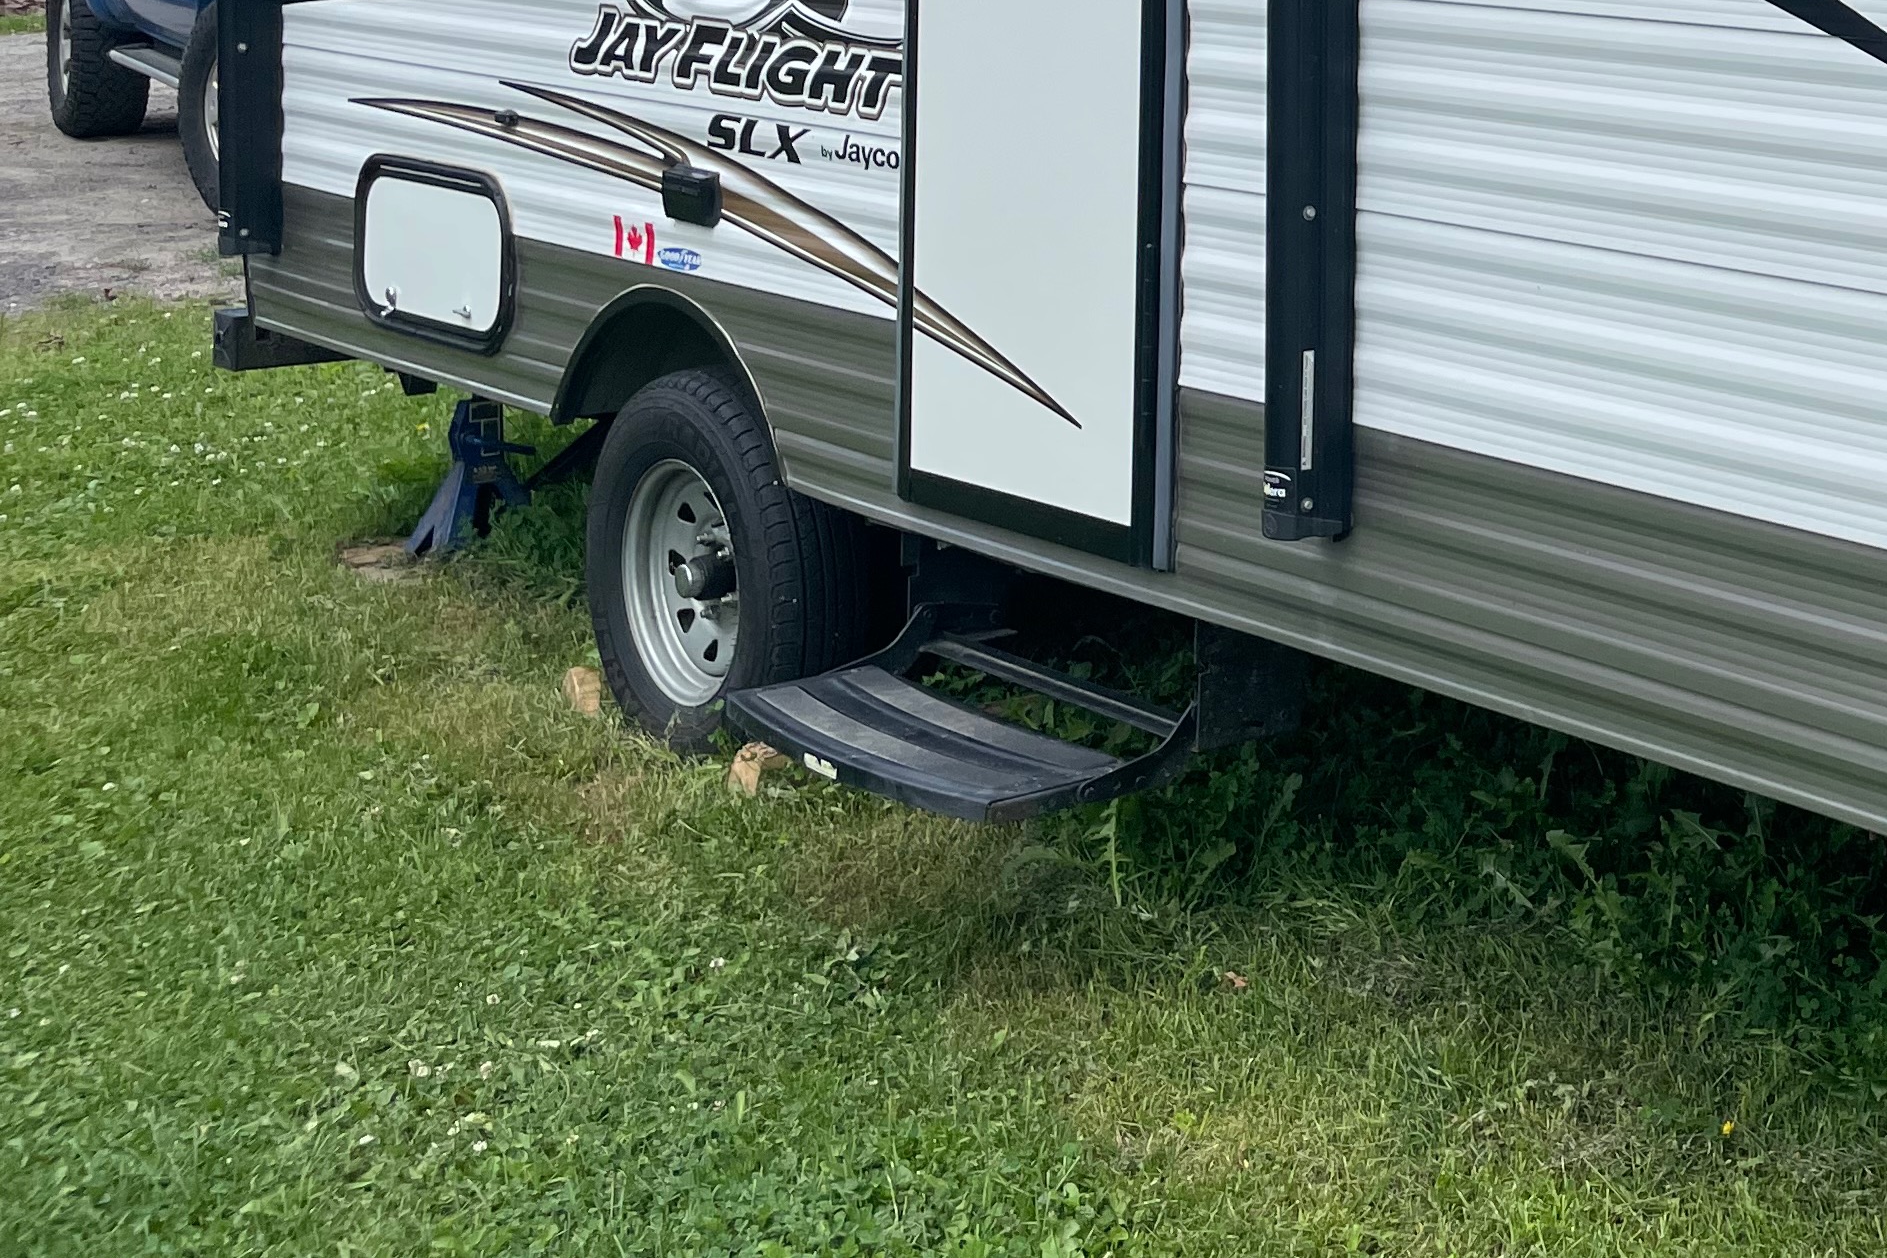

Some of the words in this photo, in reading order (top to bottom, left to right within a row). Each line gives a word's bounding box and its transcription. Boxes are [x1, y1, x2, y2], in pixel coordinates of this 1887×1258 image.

[571, 5, 684, 80] JAY
[673, 17, 902, 120] FLIGHT
[707, 114, 811, 164] SLX
[821, 145, 833, 161] by
[834, 134, 900, 169] Jayco
